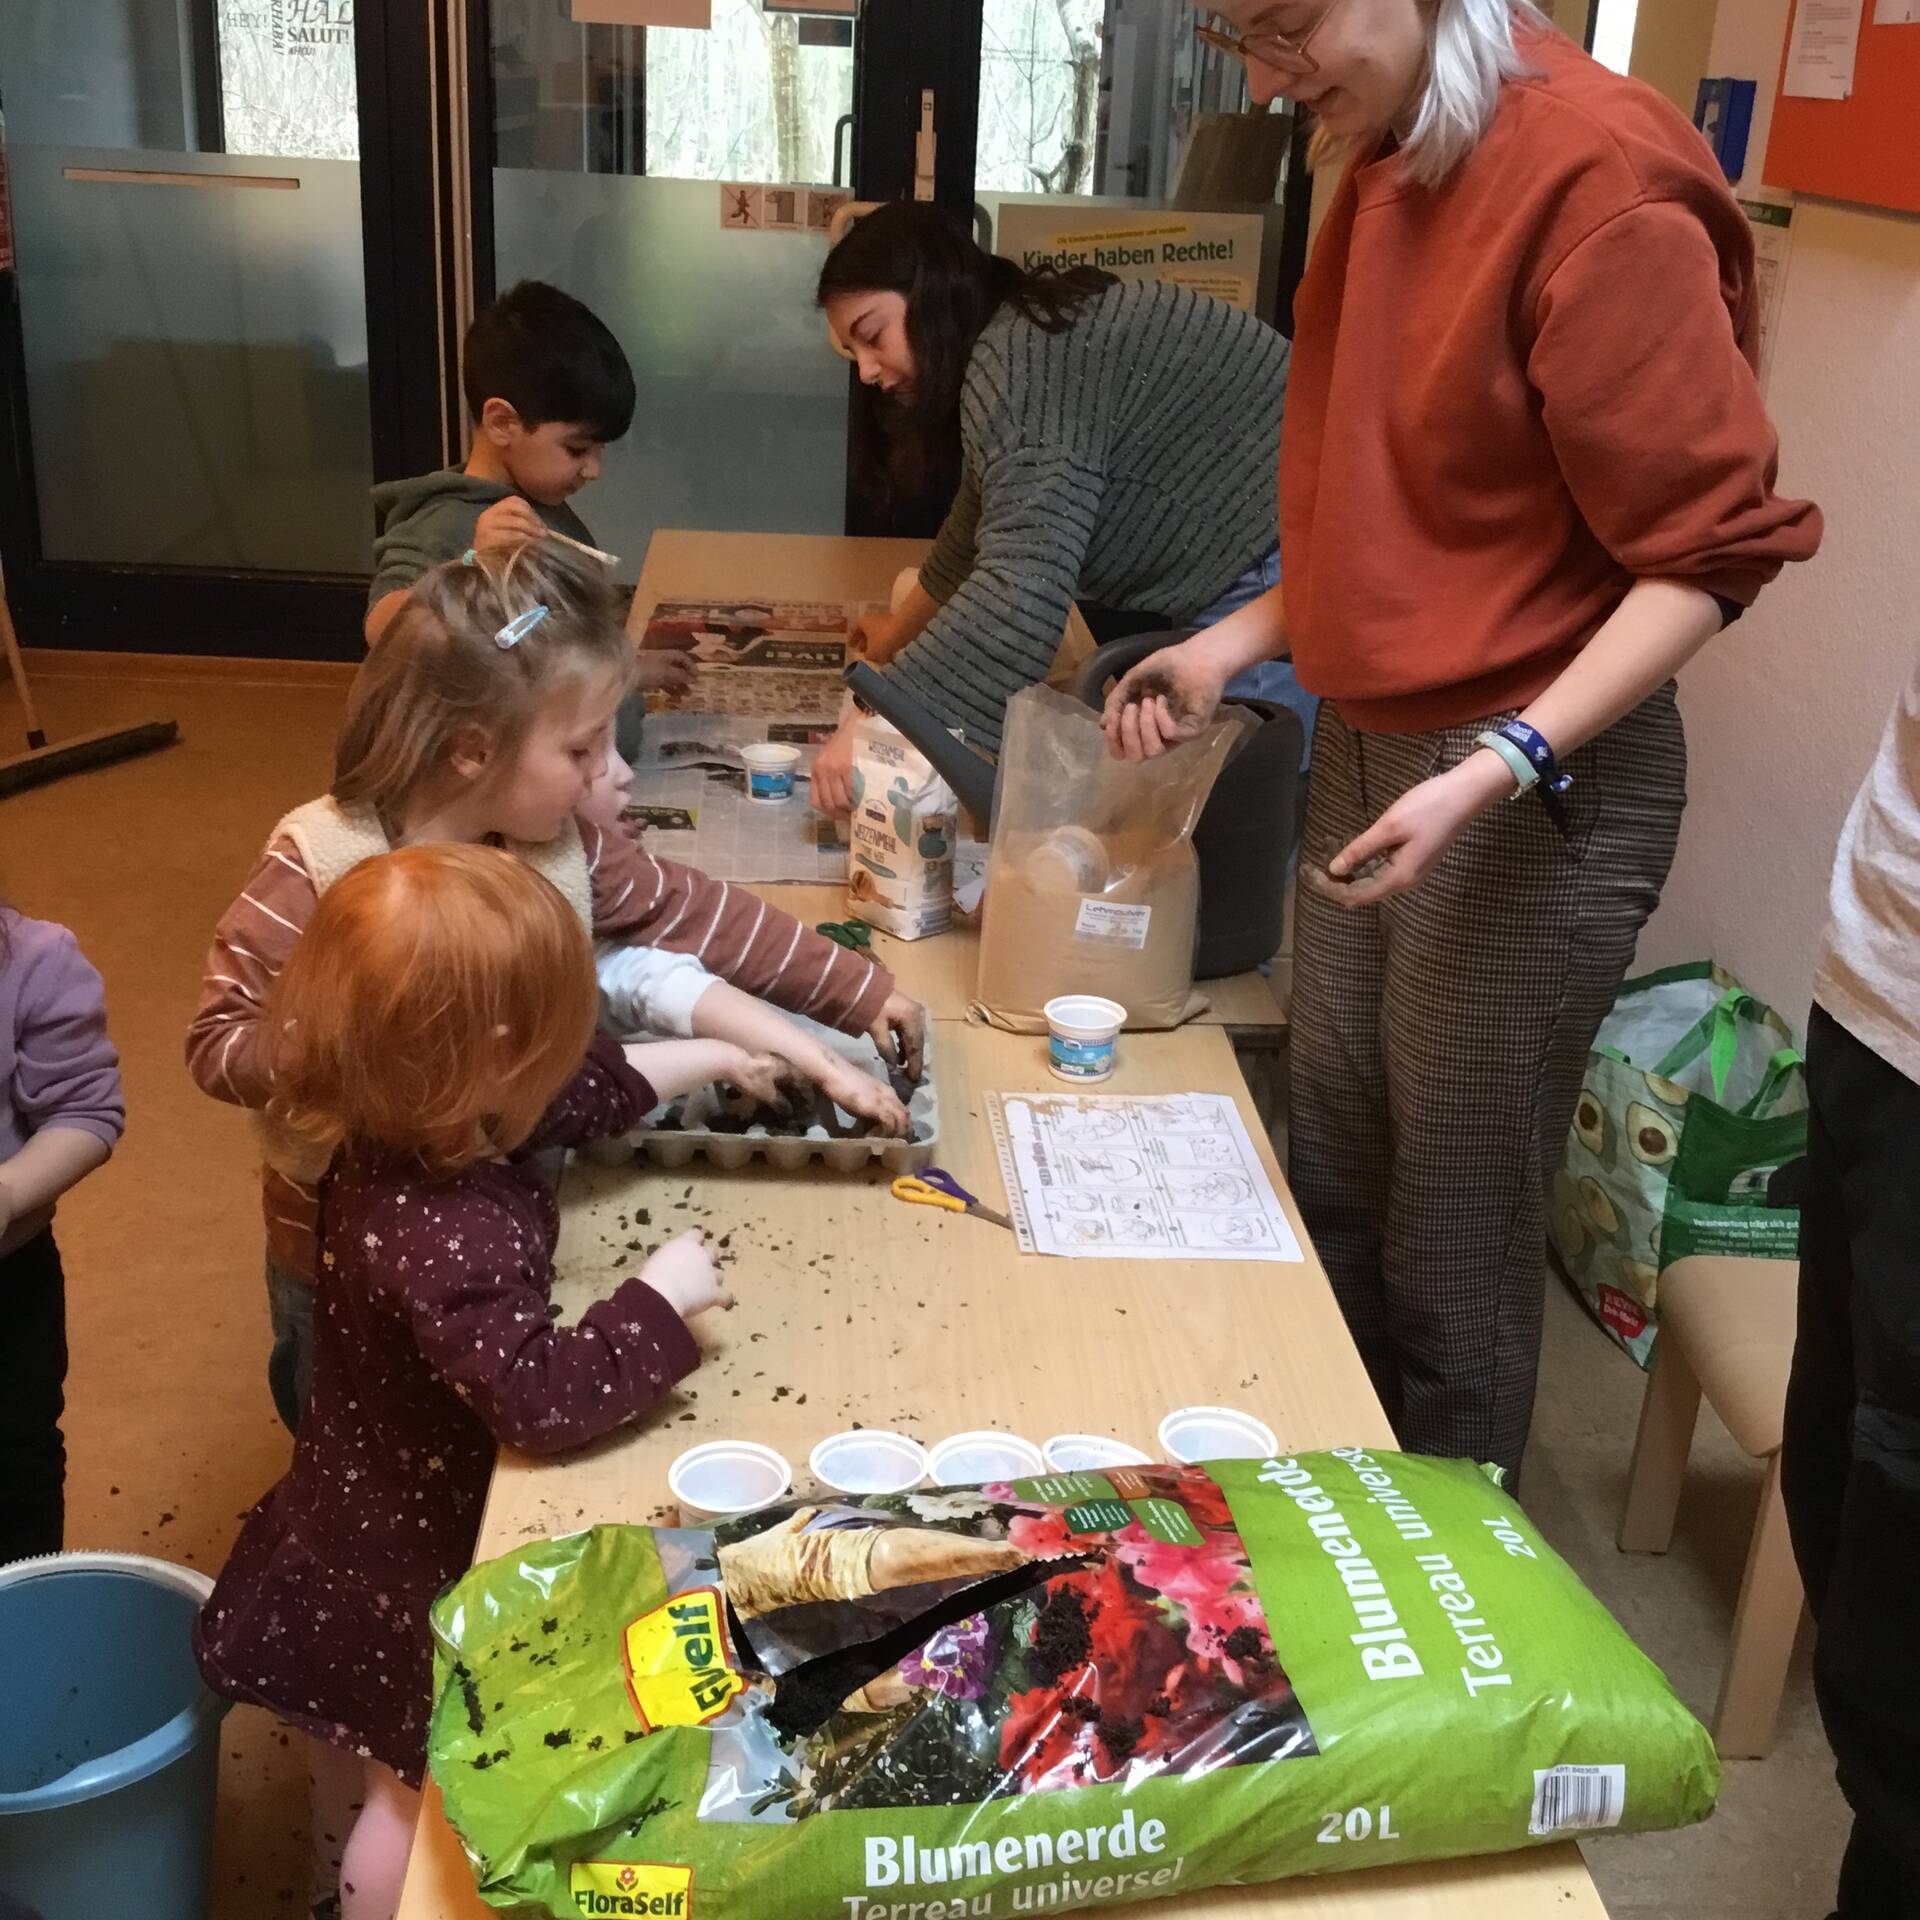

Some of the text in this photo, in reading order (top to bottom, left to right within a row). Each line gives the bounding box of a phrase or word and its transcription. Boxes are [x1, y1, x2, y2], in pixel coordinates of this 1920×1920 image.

[226, 12, 267, 28] HEY!
[287, 26, 349, 45] SALUT!
[1022, 239, 1234, 271] Kinder haben Rechte!
[855, 823, 897, 855] WEIZENMEHL
[1692, 1217, 1749, 1229] Verantwortung
[1750, 1219, 1768, 1230] trägt
[1769, 1219, 1785, 1229] sich
[1256, 1457, 1425, 1681] Blumenerde
[1331, 1447, 1513, 1698] Terreau universe
[864, 1808, 1167, 1889] Blumenerde
[574, 1887, 686, 1916] FloraSelf
[842, 1856, 1184, 1920] Terreau universel
